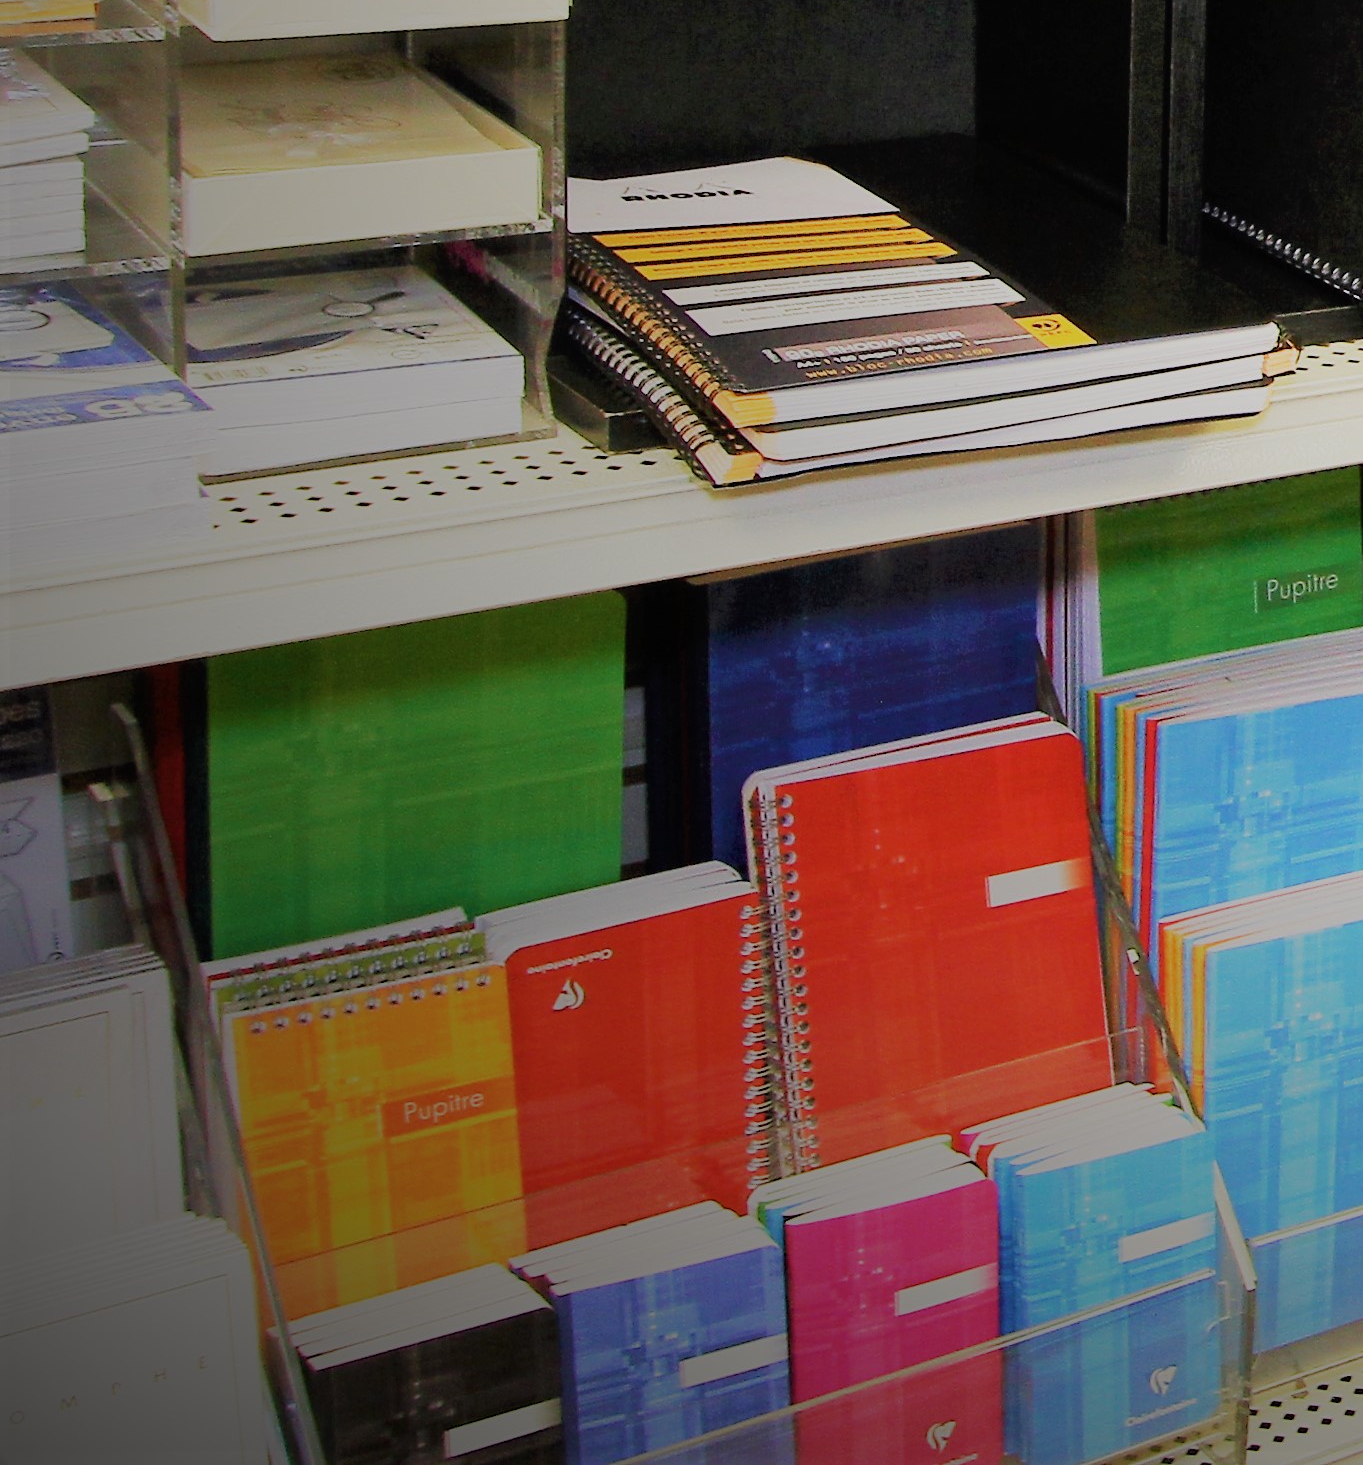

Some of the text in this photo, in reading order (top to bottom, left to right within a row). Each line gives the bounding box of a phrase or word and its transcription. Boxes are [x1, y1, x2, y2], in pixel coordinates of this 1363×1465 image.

[620, 187, 755, 204] RHODIA
[824, 335, 899, 357] RHODIA
[900, 330, 966, 347] PAPER
[1267, 574, 1339, 603] Pupitre
[403, 1091, 485, 1124] Pupitre
